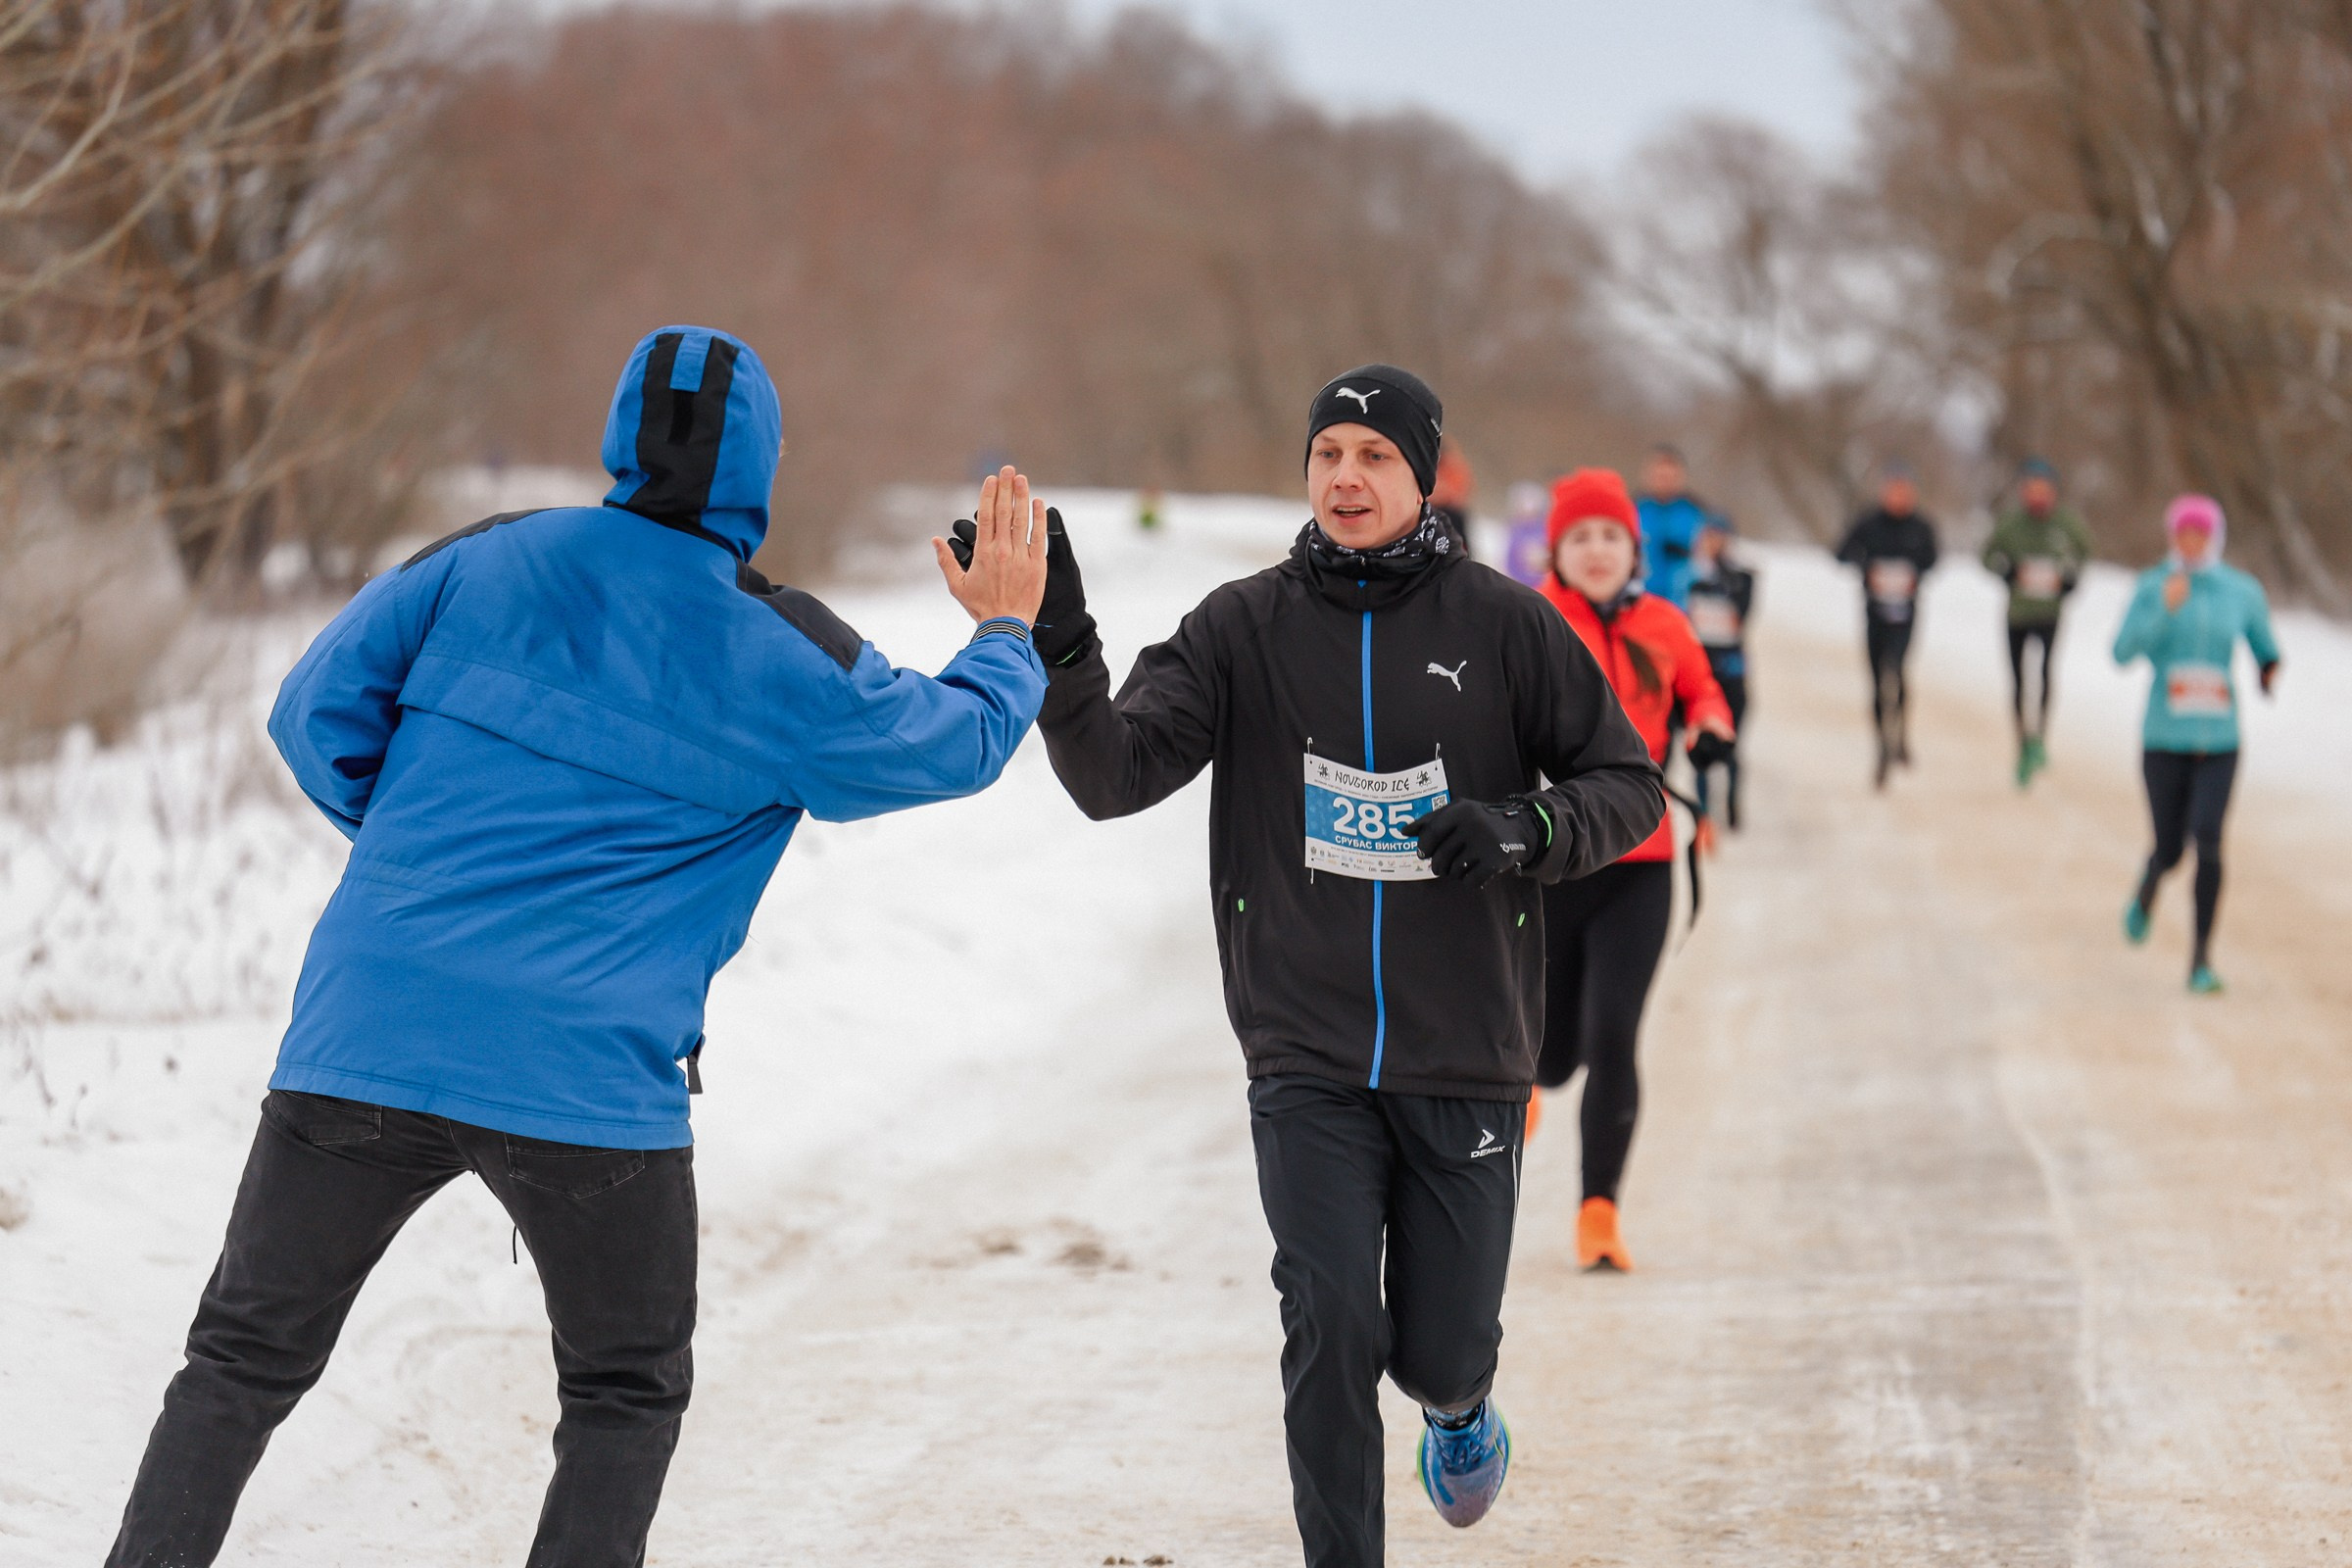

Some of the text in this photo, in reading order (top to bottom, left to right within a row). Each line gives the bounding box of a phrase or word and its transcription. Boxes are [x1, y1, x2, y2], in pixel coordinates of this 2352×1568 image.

[1335, 769, 1388, 792] NOVGOROD
[1392, 777, 1409, 792] ICE
[1332, 797, 1415, 840] 285
[1335, 835, 1418, 851] СРУБАС ВИКТОР
[1470, 1145, 1505, 1158] DEMIX
